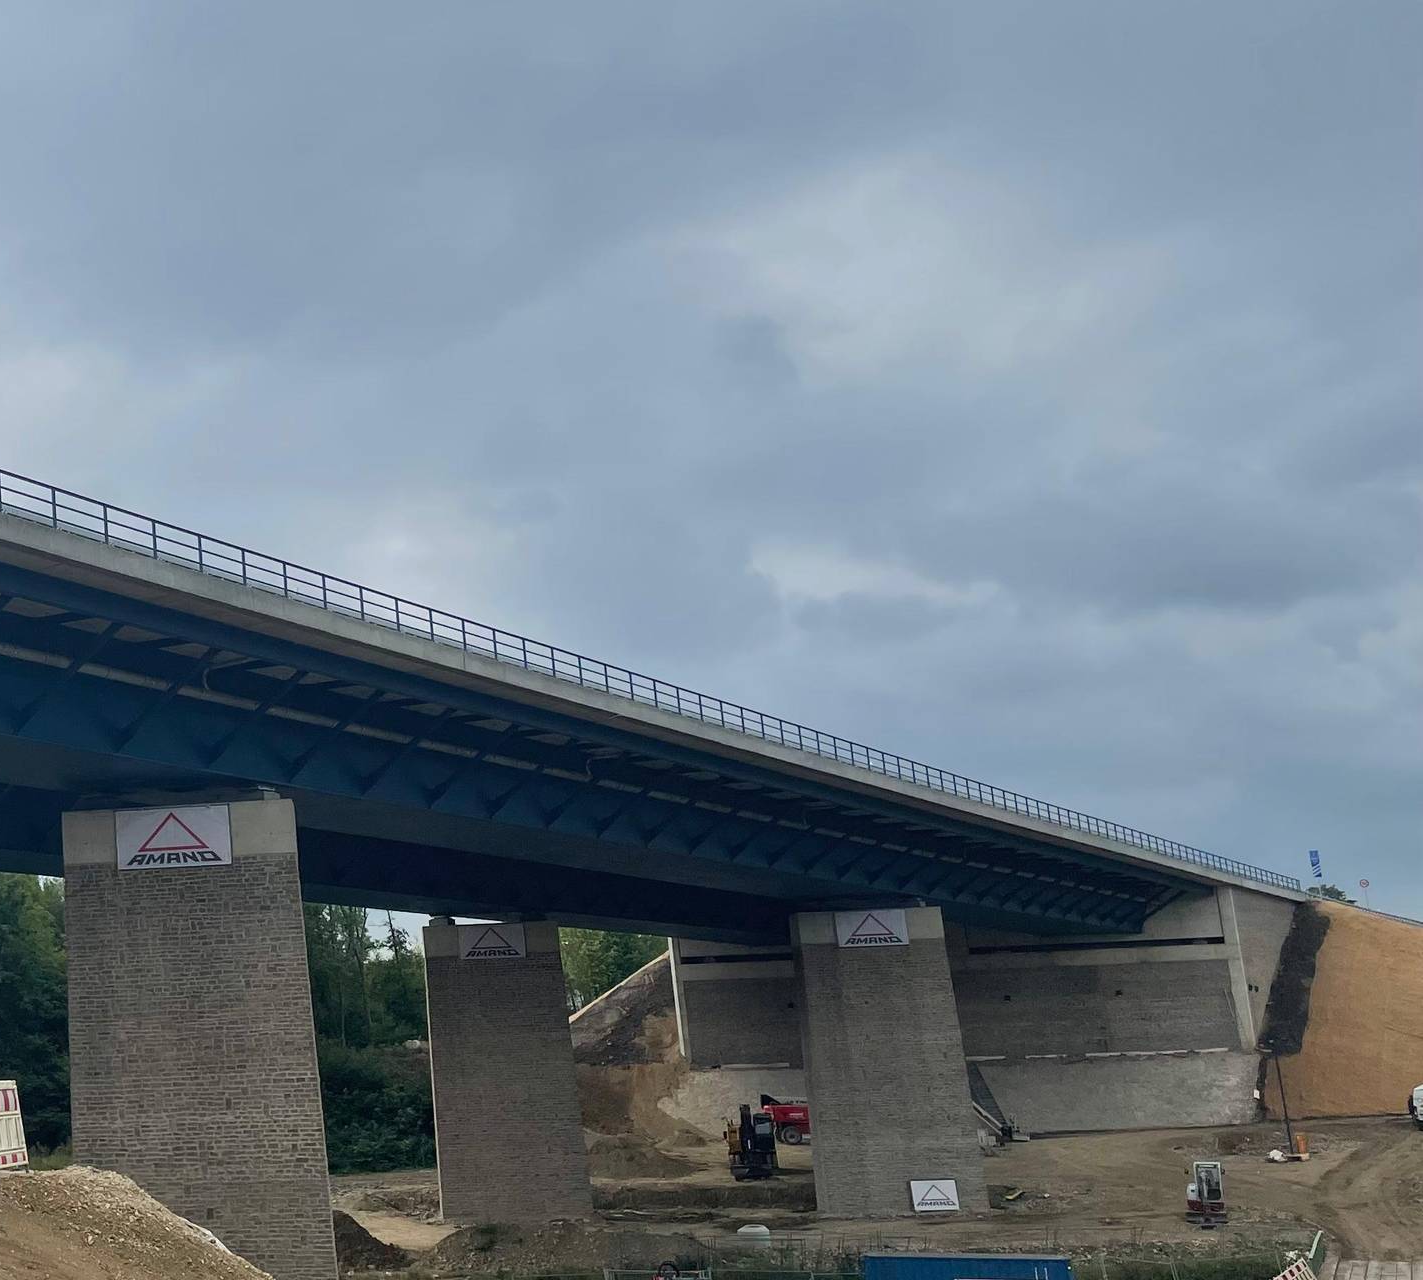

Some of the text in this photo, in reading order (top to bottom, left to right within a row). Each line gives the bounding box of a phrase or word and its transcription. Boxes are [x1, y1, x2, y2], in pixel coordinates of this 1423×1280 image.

[127, 851, 222, 866] AMAND
[844, 936, 903, 945] AMAND
[465, 949, 521, 958] AMAND
